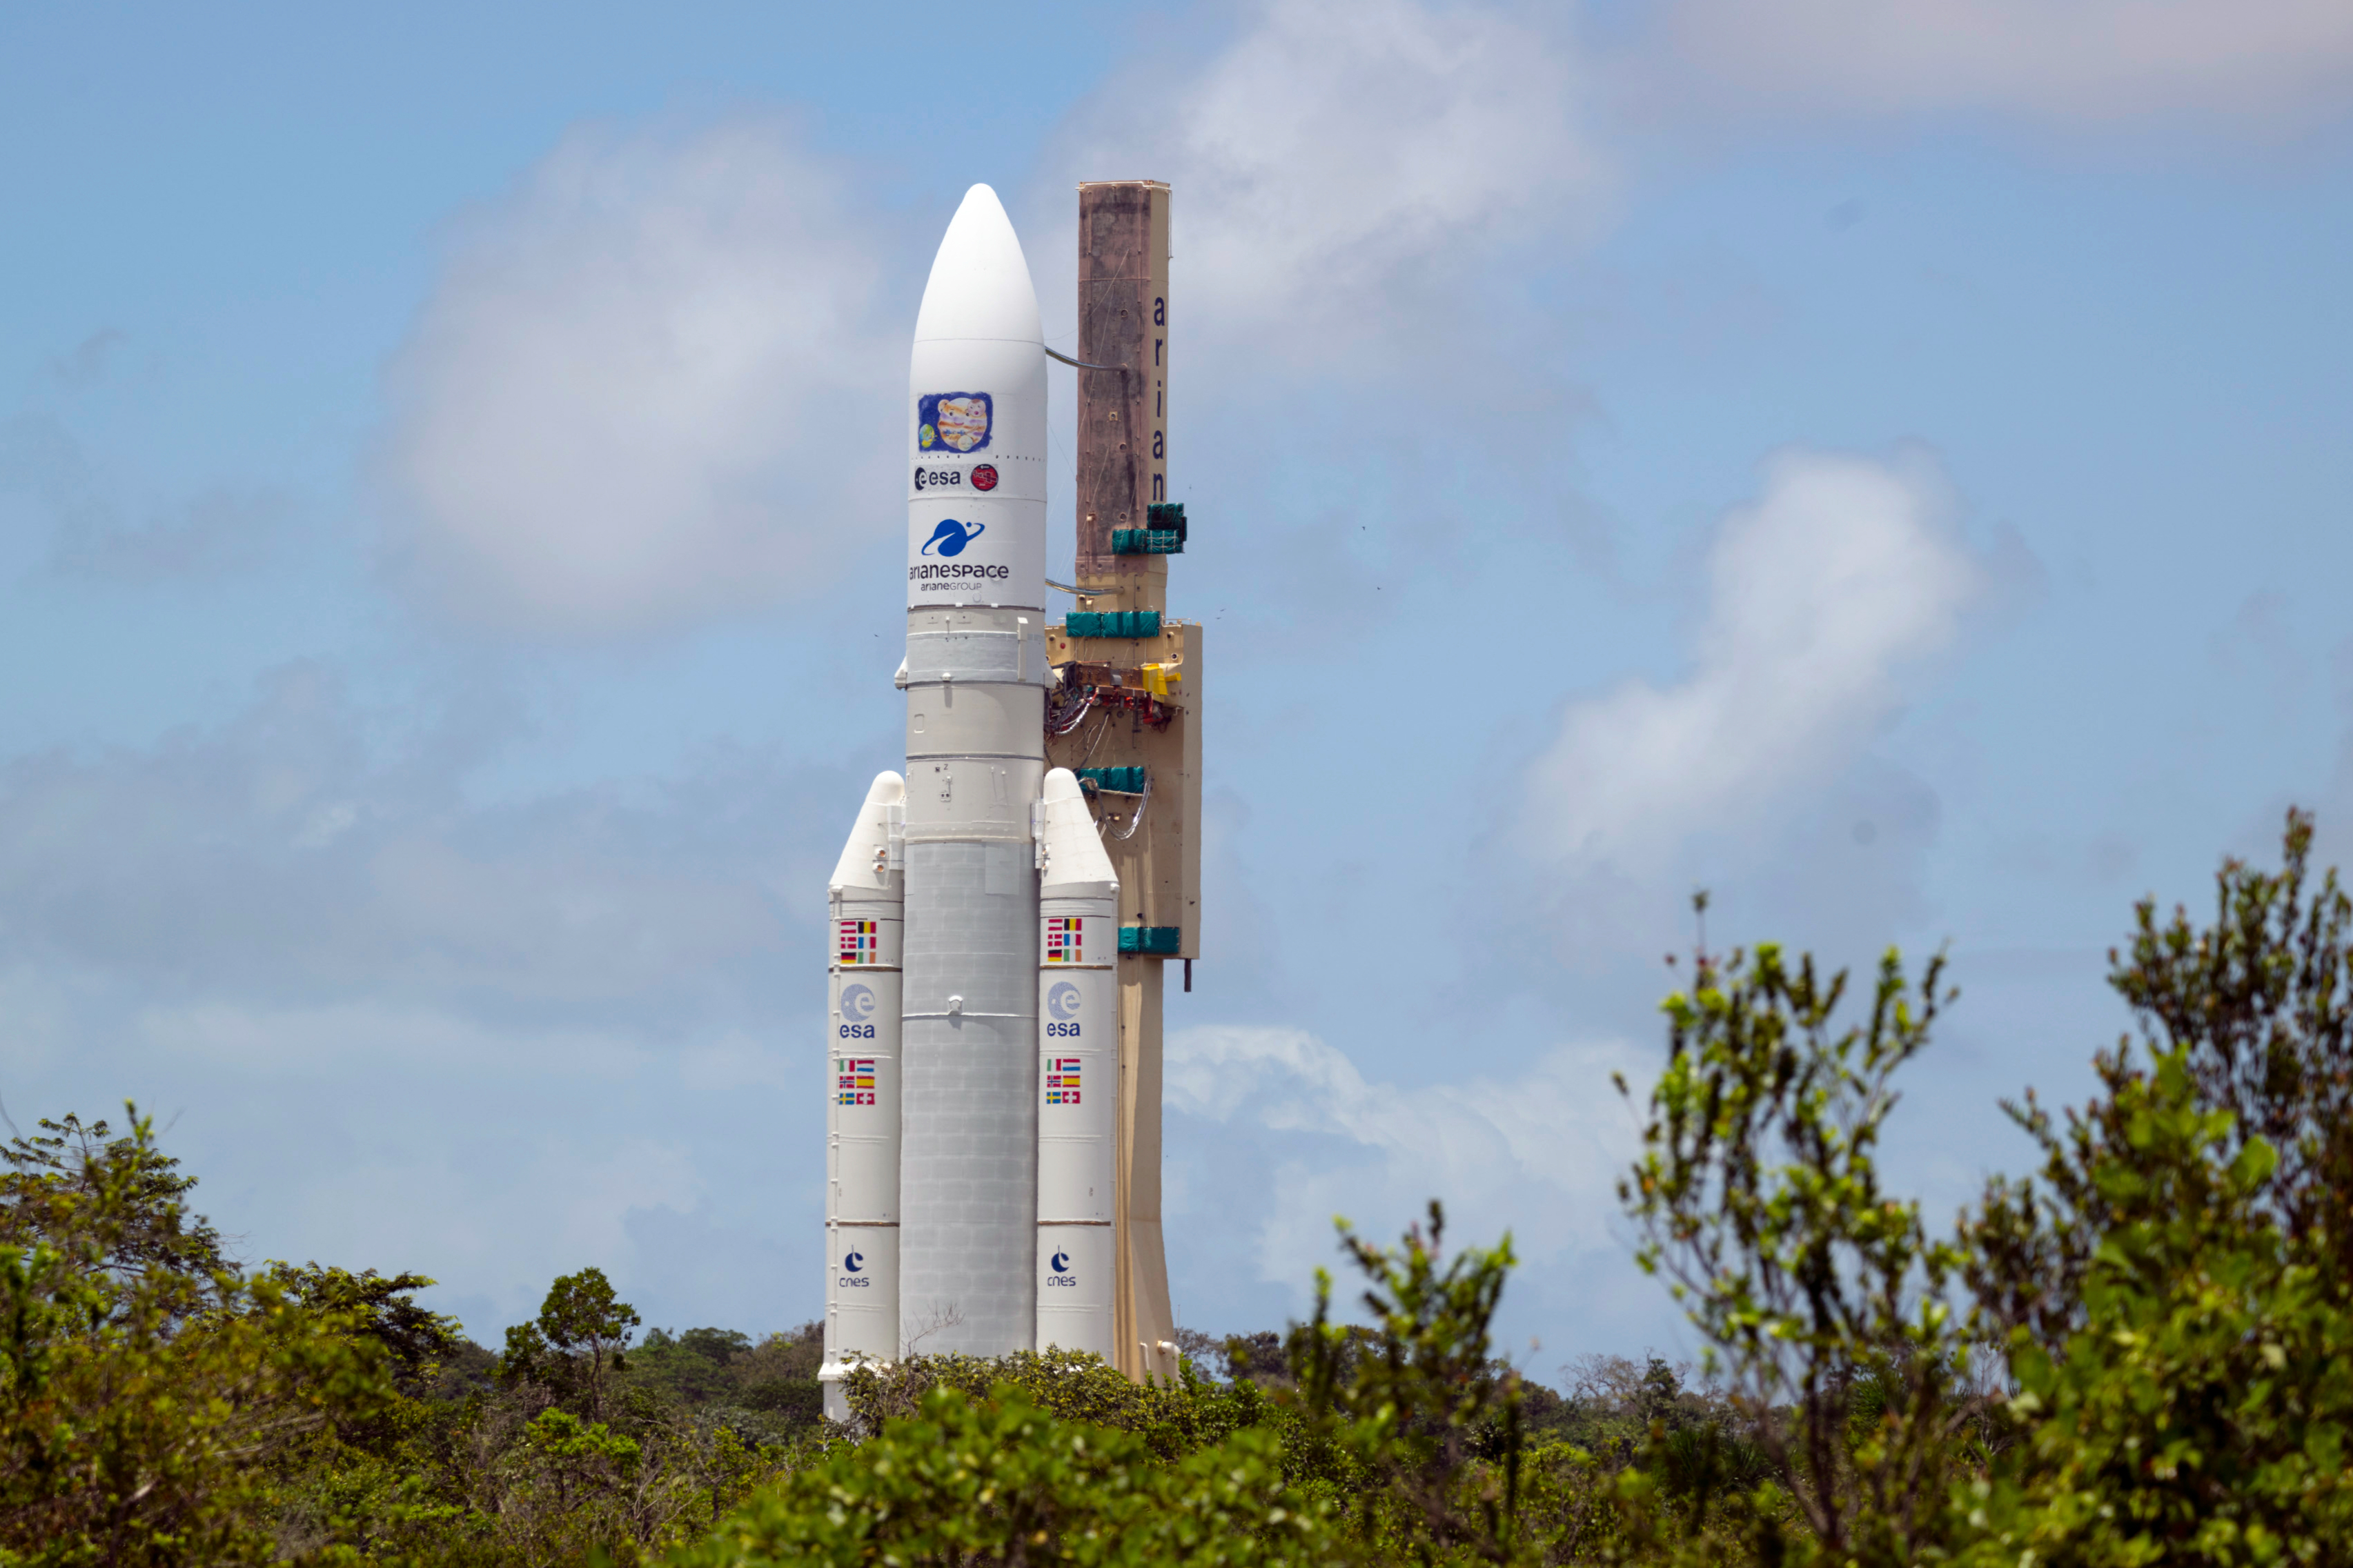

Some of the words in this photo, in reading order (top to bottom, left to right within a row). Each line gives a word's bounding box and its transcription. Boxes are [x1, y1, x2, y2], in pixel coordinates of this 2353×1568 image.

[929, 471, 961, 486] esa
[909, 564, 1009, 580] arianespace
[840, 1024, 875, 1038] esa
[1047, 1022, 1081, 1037] esa
[839, 1277, 869, 1287] cnes
[1047, 1276, 1076, 1287] cnes
